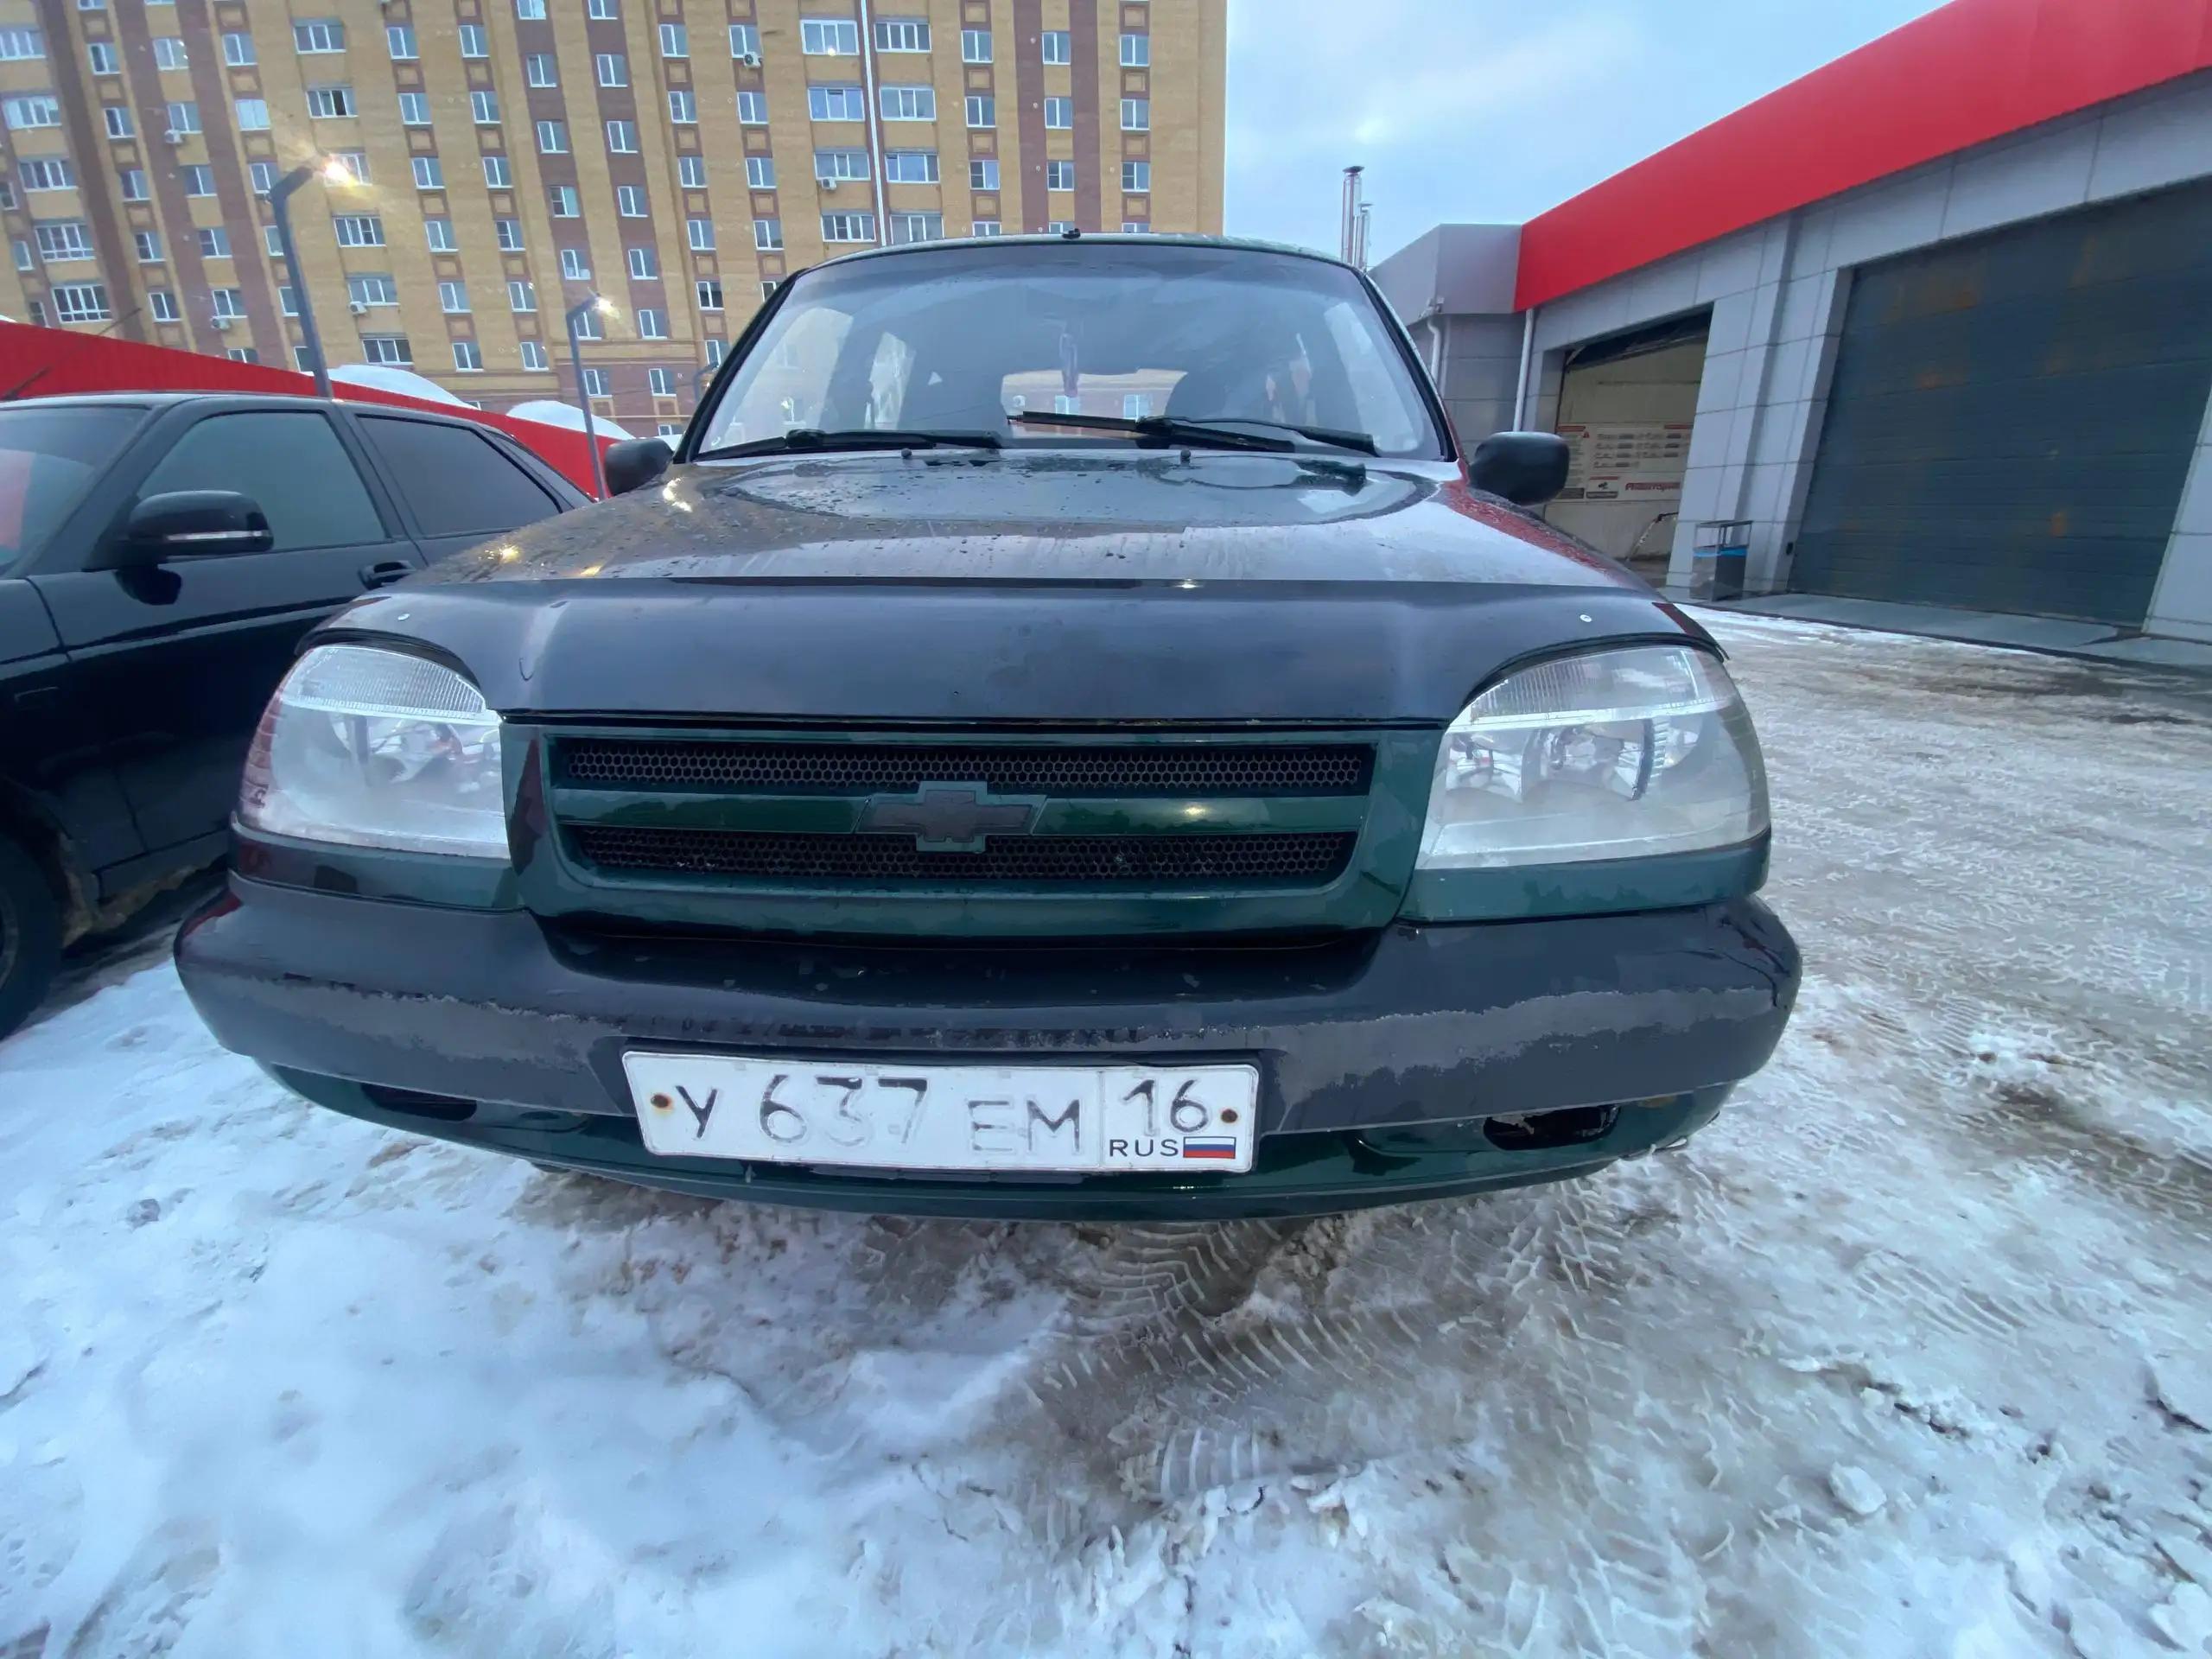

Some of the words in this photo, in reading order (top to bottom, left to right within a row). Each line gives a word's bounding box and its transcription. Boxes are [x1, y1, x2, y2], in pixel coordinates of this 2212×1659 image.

[759, 1073, 929, 1147] 637
[1122, 1078, 1208, 1135] 16
[1109, 1138, 1179, 1158] RUS
